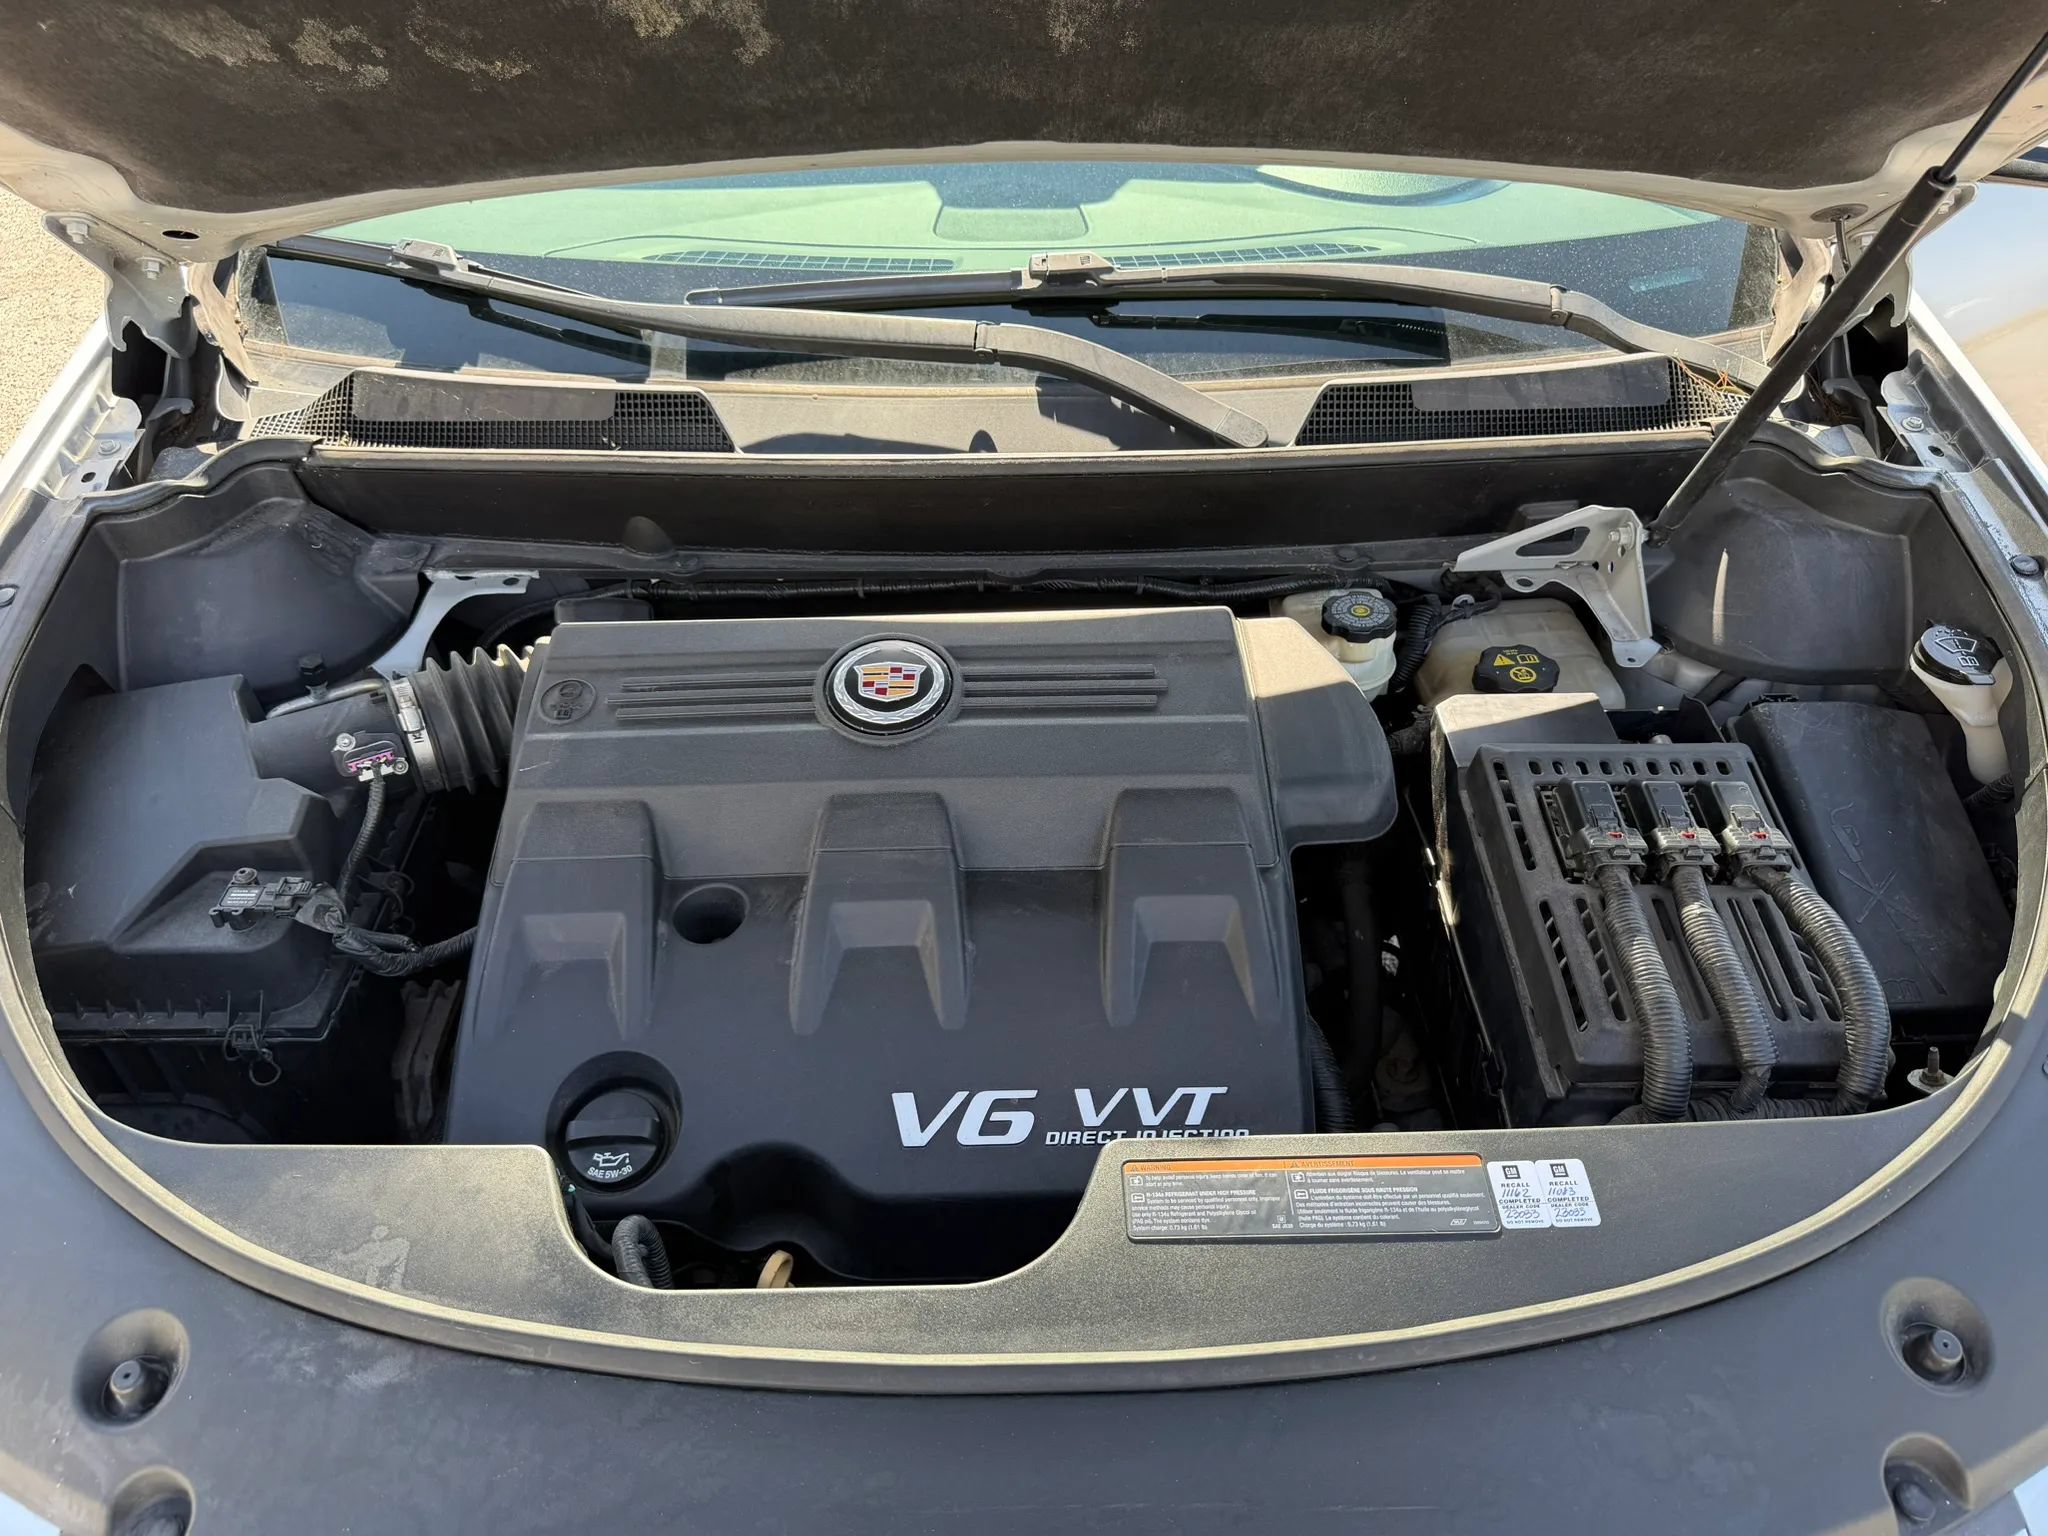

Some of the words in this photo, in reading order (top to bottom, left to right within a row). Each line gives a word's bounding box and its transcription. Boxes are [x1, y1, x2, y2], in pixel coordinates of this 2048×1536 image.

[892, 1089, 1038, 1147] V6
[1074, 1086, 1228, 1127] VVT
[1045, 1130, 1127, 1145] DIRECT
[588, 1166, 605, 1178] SAE
[605, 1165, 632, 1179] 5W-30
